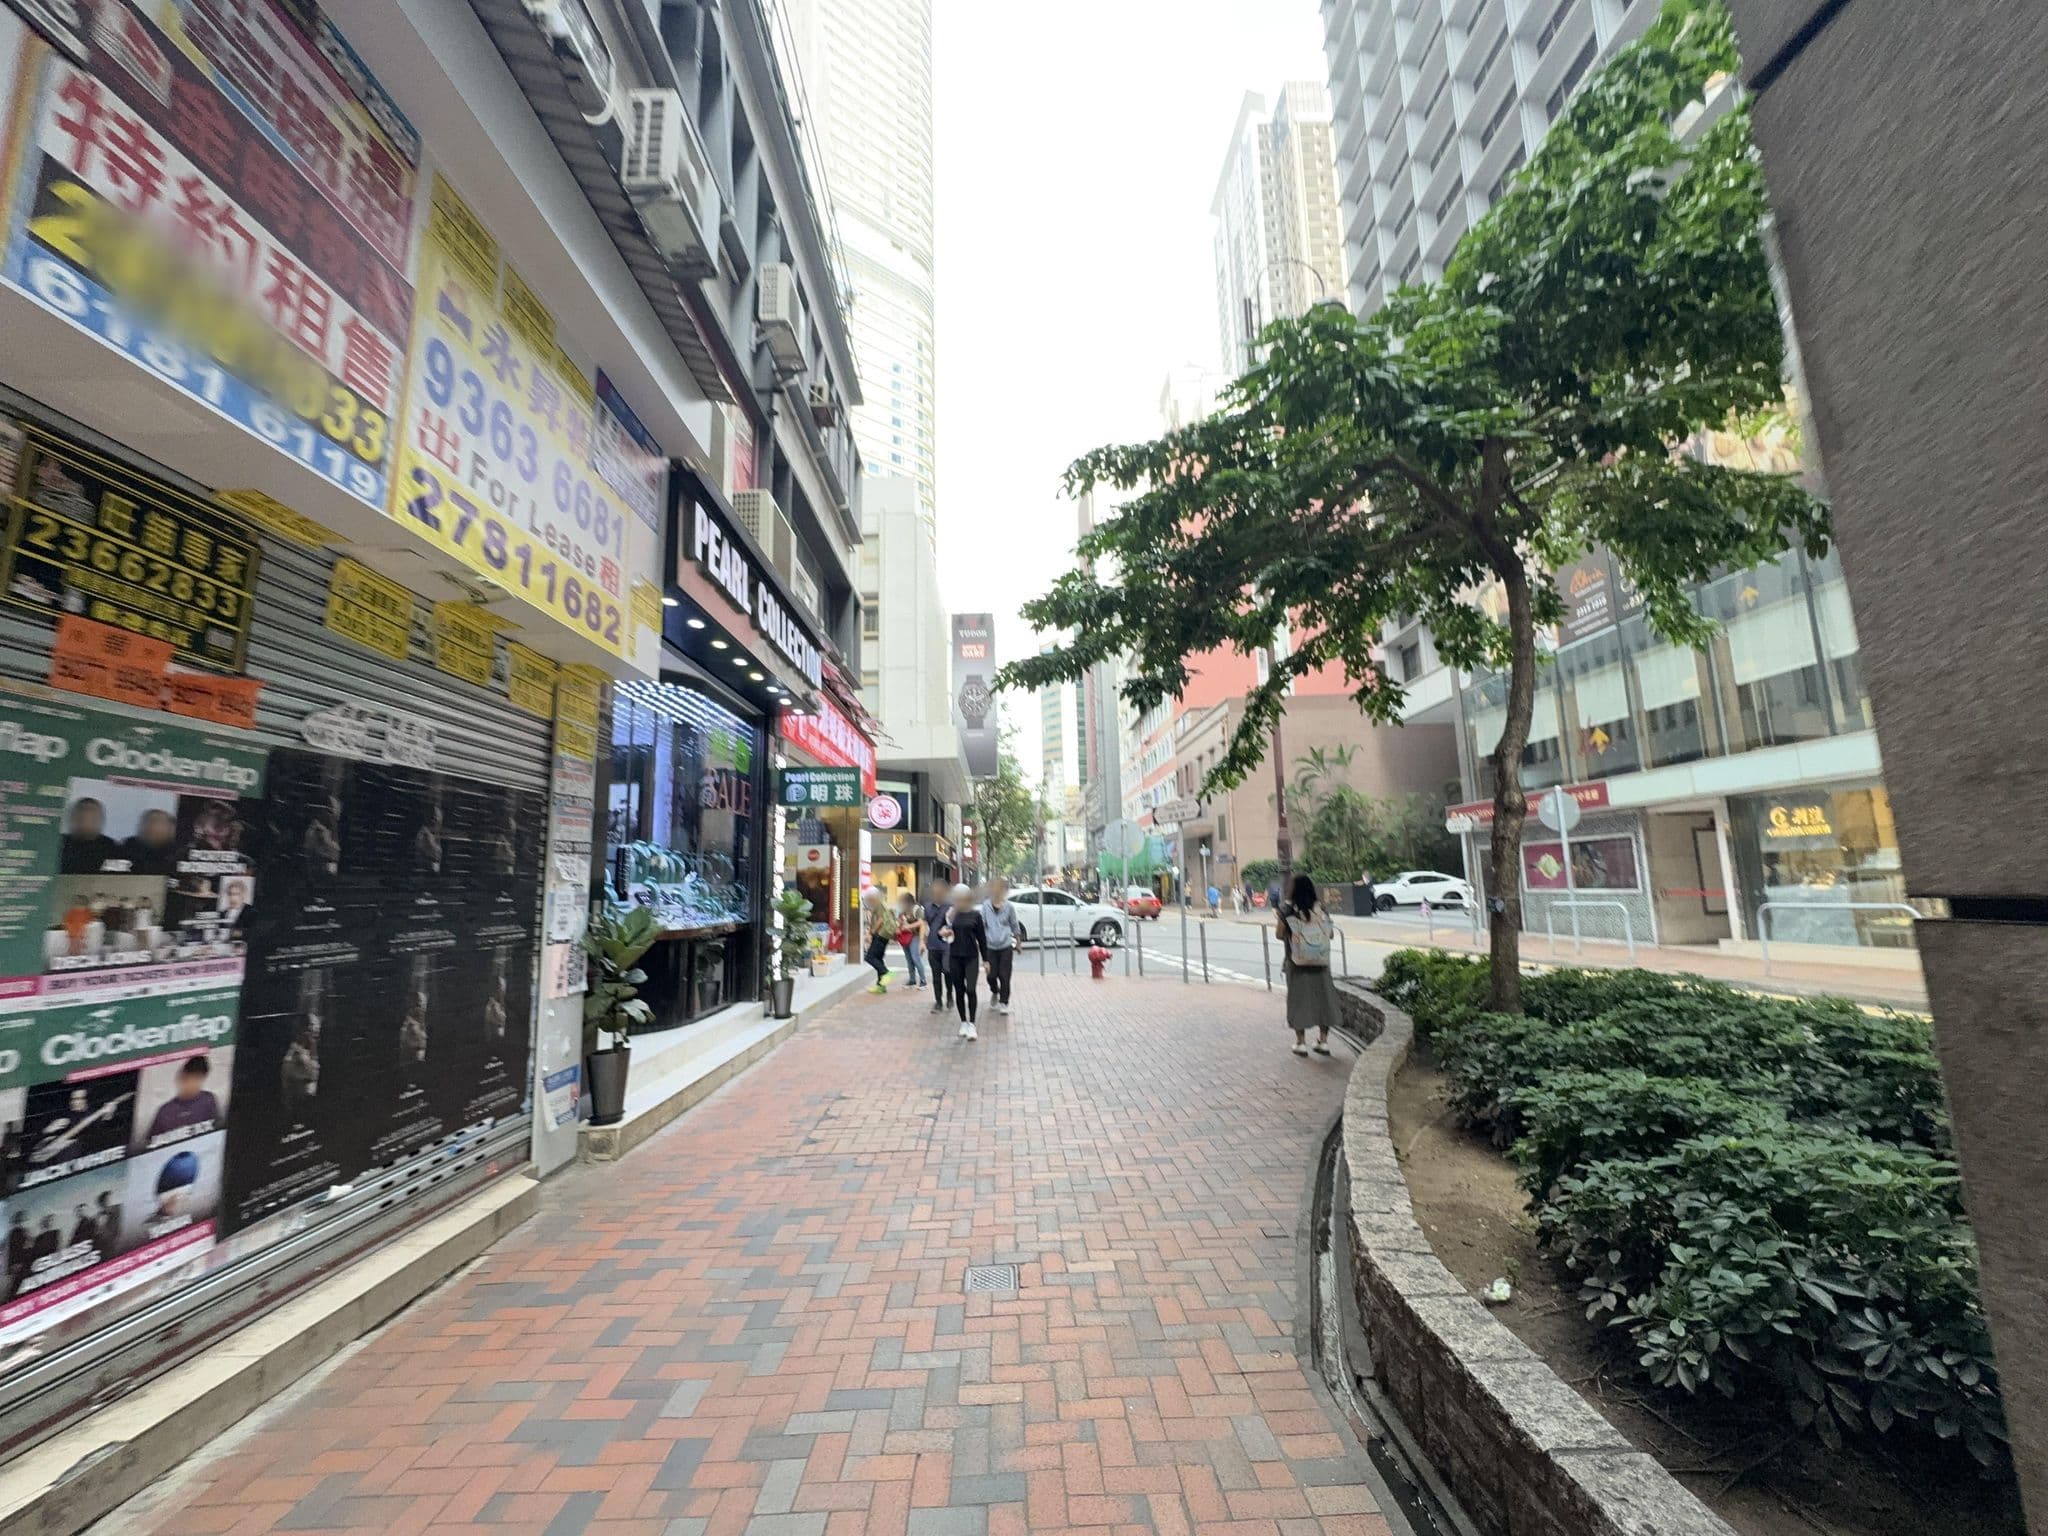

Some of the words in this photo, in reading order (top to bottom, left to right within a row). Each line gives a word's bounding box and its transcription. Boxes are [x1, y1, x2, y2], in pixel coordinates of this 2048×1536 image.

[249, 401, 379, 500] 6119
[423, 336, 538, 483] 9363
[552, 458, 624, 561] 6681
[418, 406, 461, 477] 出
[470, 452, 518, 515] For
[528, 498, 597, 579] Lease
[601, 555, 621, 600] 租
[26, 515, 238, 618] 23662833
[407, 466, 621, 647] 27811682
[694, 500, 752, 616] PEARL
[757, 581, 822, 690] COLLECTION
[85, 738, 260, 790] Clockenflap
[784, 772, 809, 783] Pearl
[810, 771, 856, 782] Collection
[810, 783, 854, 802] 明珠
[41, 1013, 233, 1067] Clockenflap
